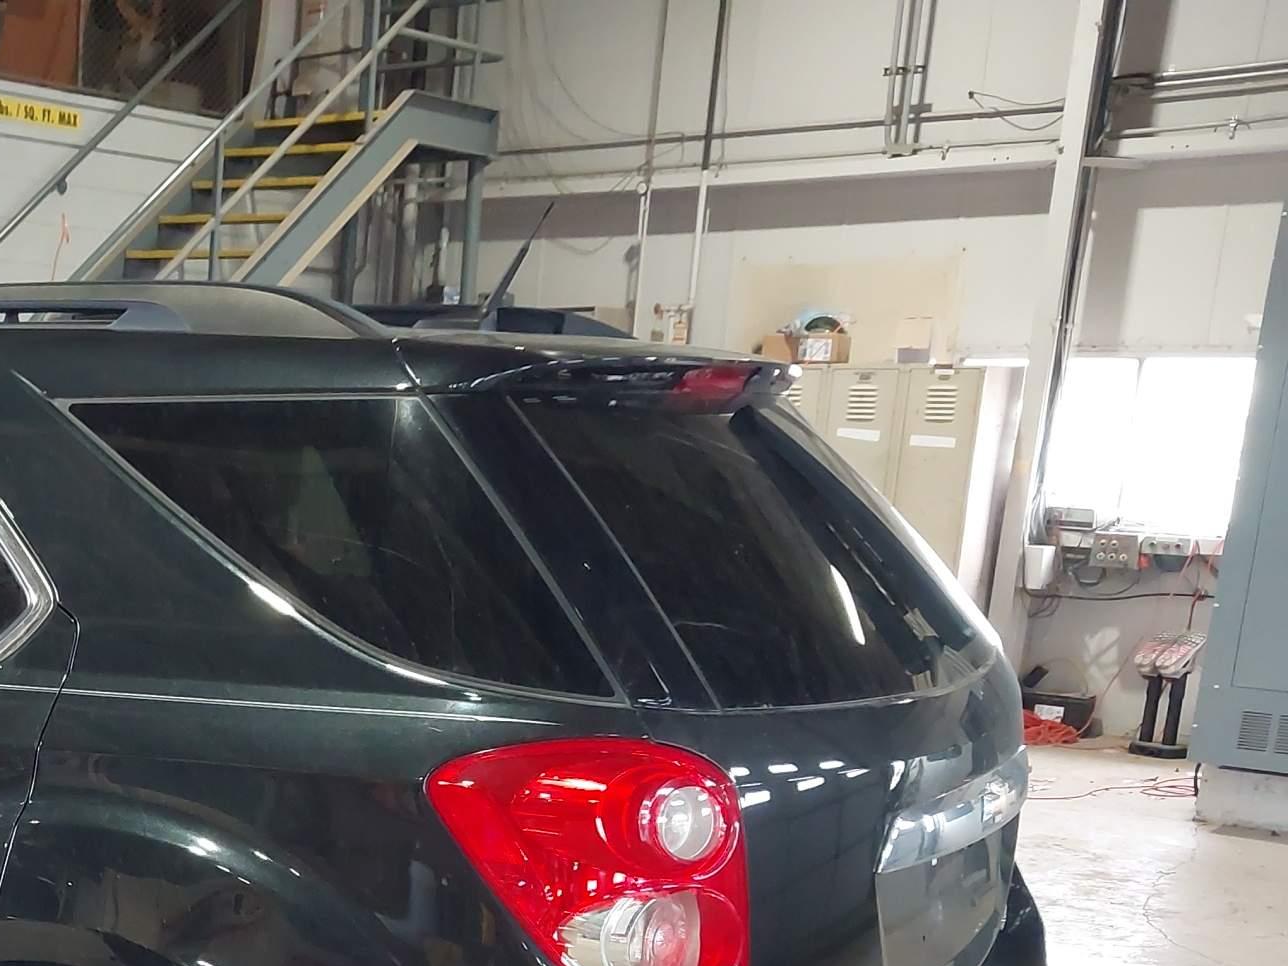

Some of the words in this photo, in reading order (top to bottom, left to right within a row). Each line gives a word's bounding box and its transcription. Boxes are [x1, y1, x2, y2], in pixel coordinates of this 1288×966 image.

[24, 104, 39, 121] SQ.
[42, 108, 55, 124] FT.
[58, 111, 78, 127] MAX
